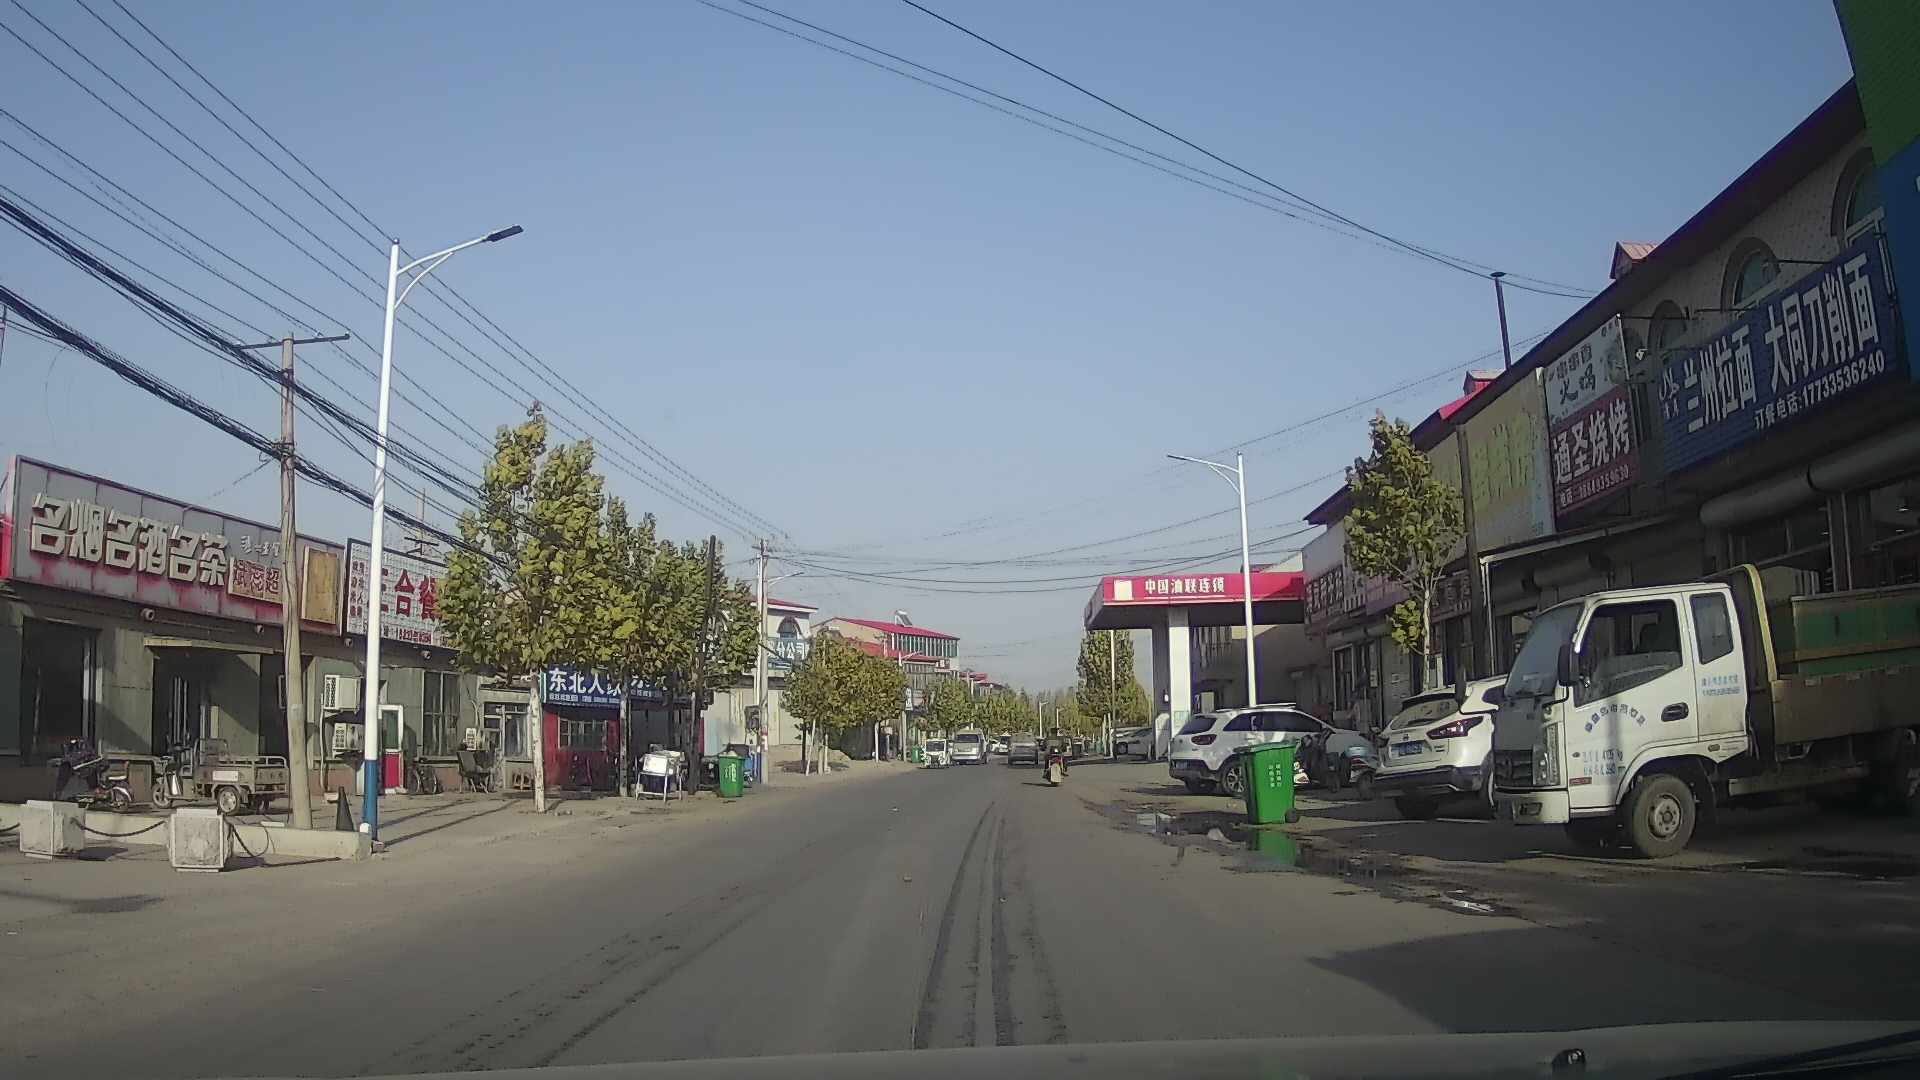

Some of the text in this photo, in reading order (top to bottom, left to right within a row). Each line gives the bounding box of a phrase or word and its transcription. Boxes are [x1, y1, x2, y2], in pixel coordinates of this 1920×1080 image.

[1684, 252, 1879, 433] 兰州拉面 大同刀削面
[1553, 398, 1630, 484] 通圣烧烤
[31, 493, 228, 586] 名烟名酒名茶
[1145, 577, 1226, 594] 中国油联连锁
